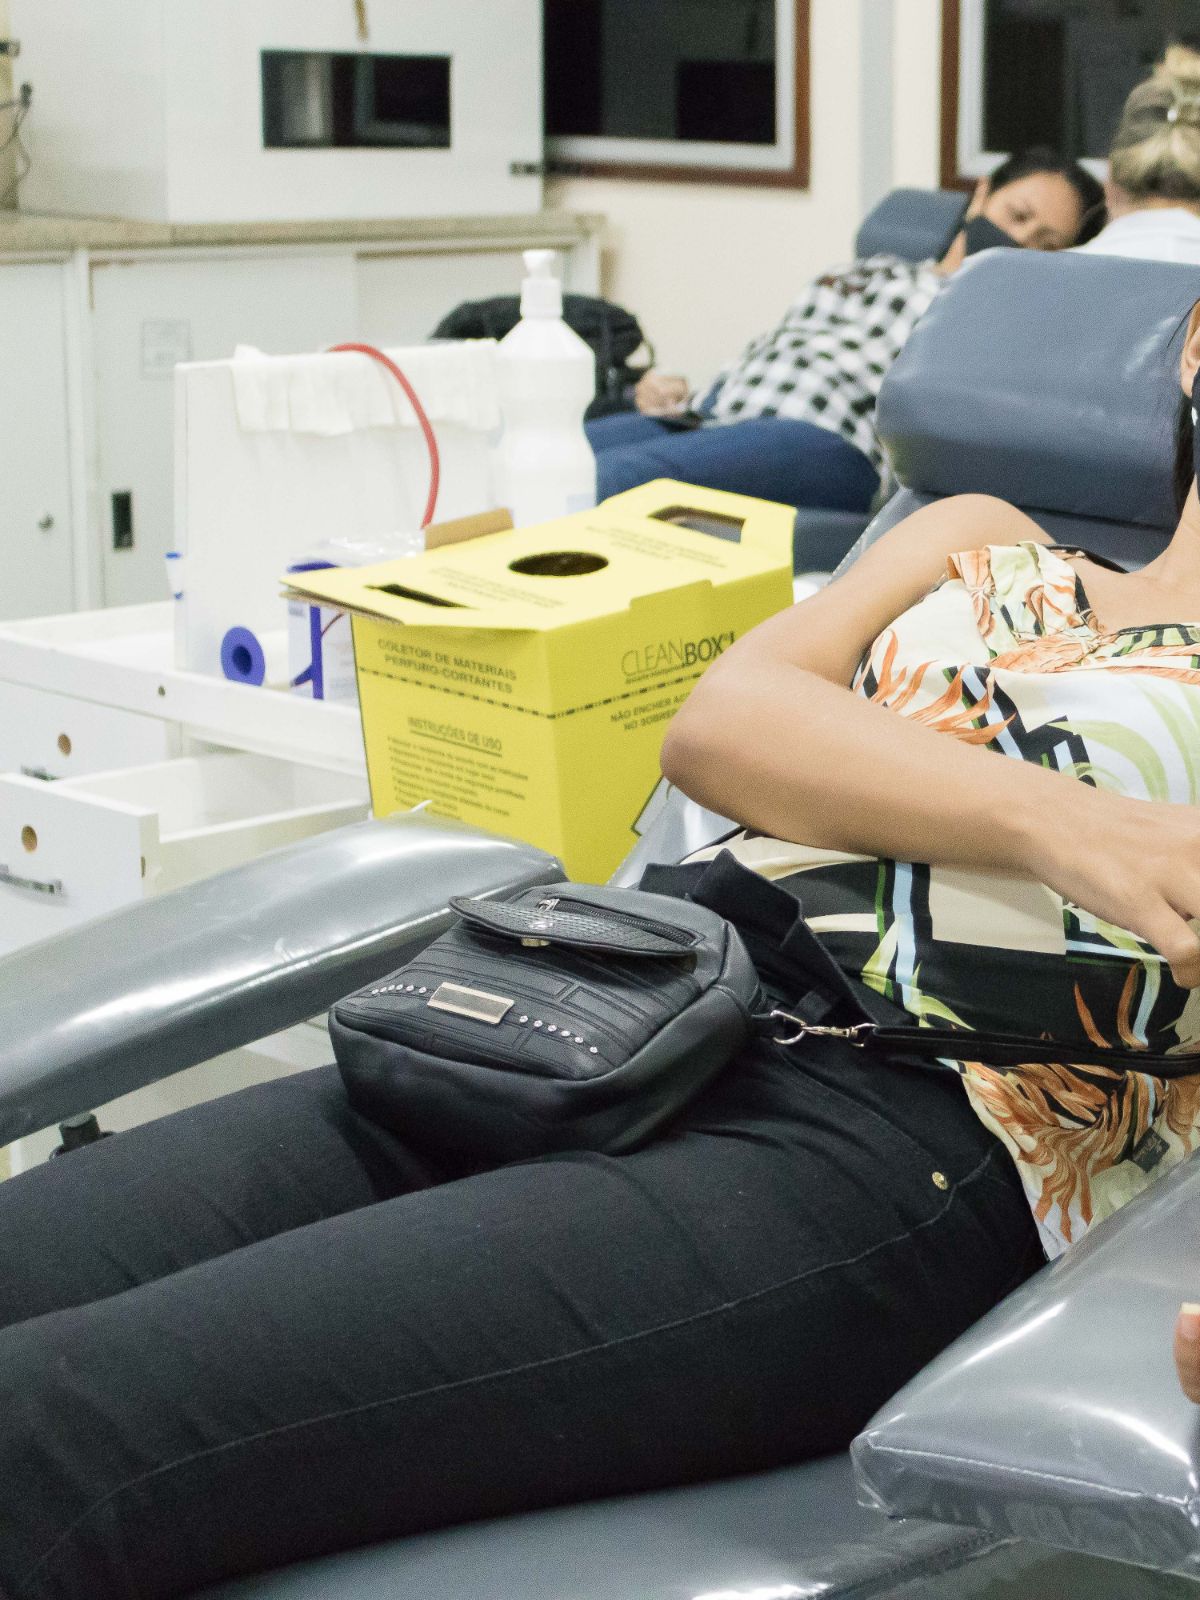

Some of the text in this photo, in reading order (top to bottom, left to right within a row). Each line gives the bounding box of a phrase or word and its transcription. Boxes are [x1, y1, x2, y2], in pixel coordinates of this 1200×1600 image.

[377, 638, 517, 681] COLETOR DE MATERIAIS
[467, 731, 480, 745] DE
[482, 735, 502, 751] USO
